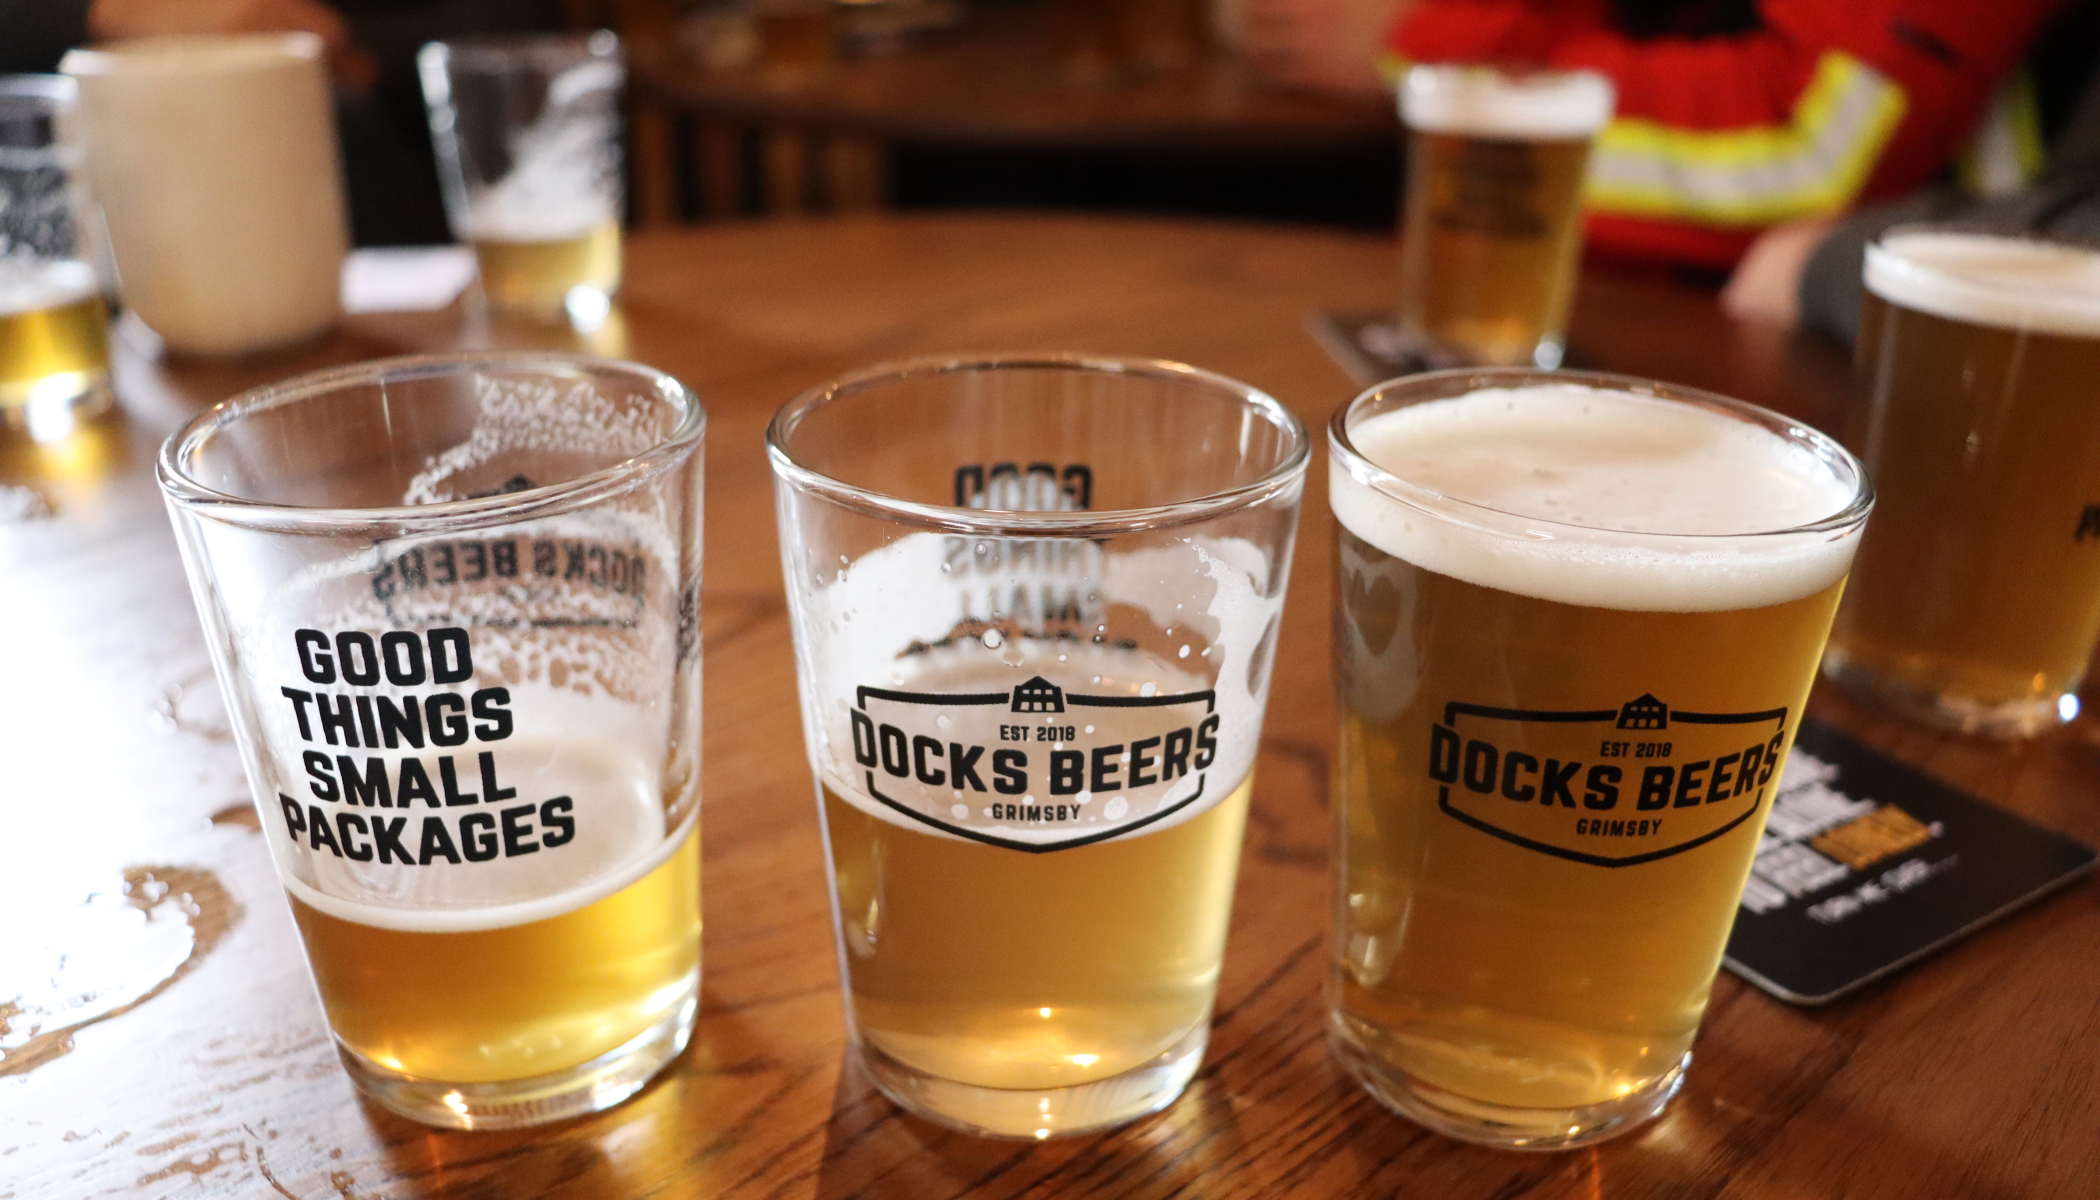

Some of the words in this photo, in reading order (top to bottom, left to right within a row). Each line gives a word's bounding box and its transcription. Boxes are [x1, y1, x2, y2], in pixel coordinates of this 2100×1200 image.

[294, 626, 474, 687] GOOD
[280, 686, 514, 749] THINGS
[1000, 725, 1030, 741] EST
[1036, 725, 1076, 742] 2018
[302, 750, 517, 809] SMALL
[850, 708, 1028, 795] DOCKS
[1050, 713, 1220, 796] BEERS
[1428, 722, 1623, 811] DOCKS
[1636, 730, 1785, 811] BEERS
[1600, 741, 1631, 758] EST
[1635, 742, 1672, 758] 2018
[278, 793, 576, 866] PACKAGES
[992, 803, 1081, 822] GRIMSBY
[1576, 818, 1663, 837] GRIMSBY
